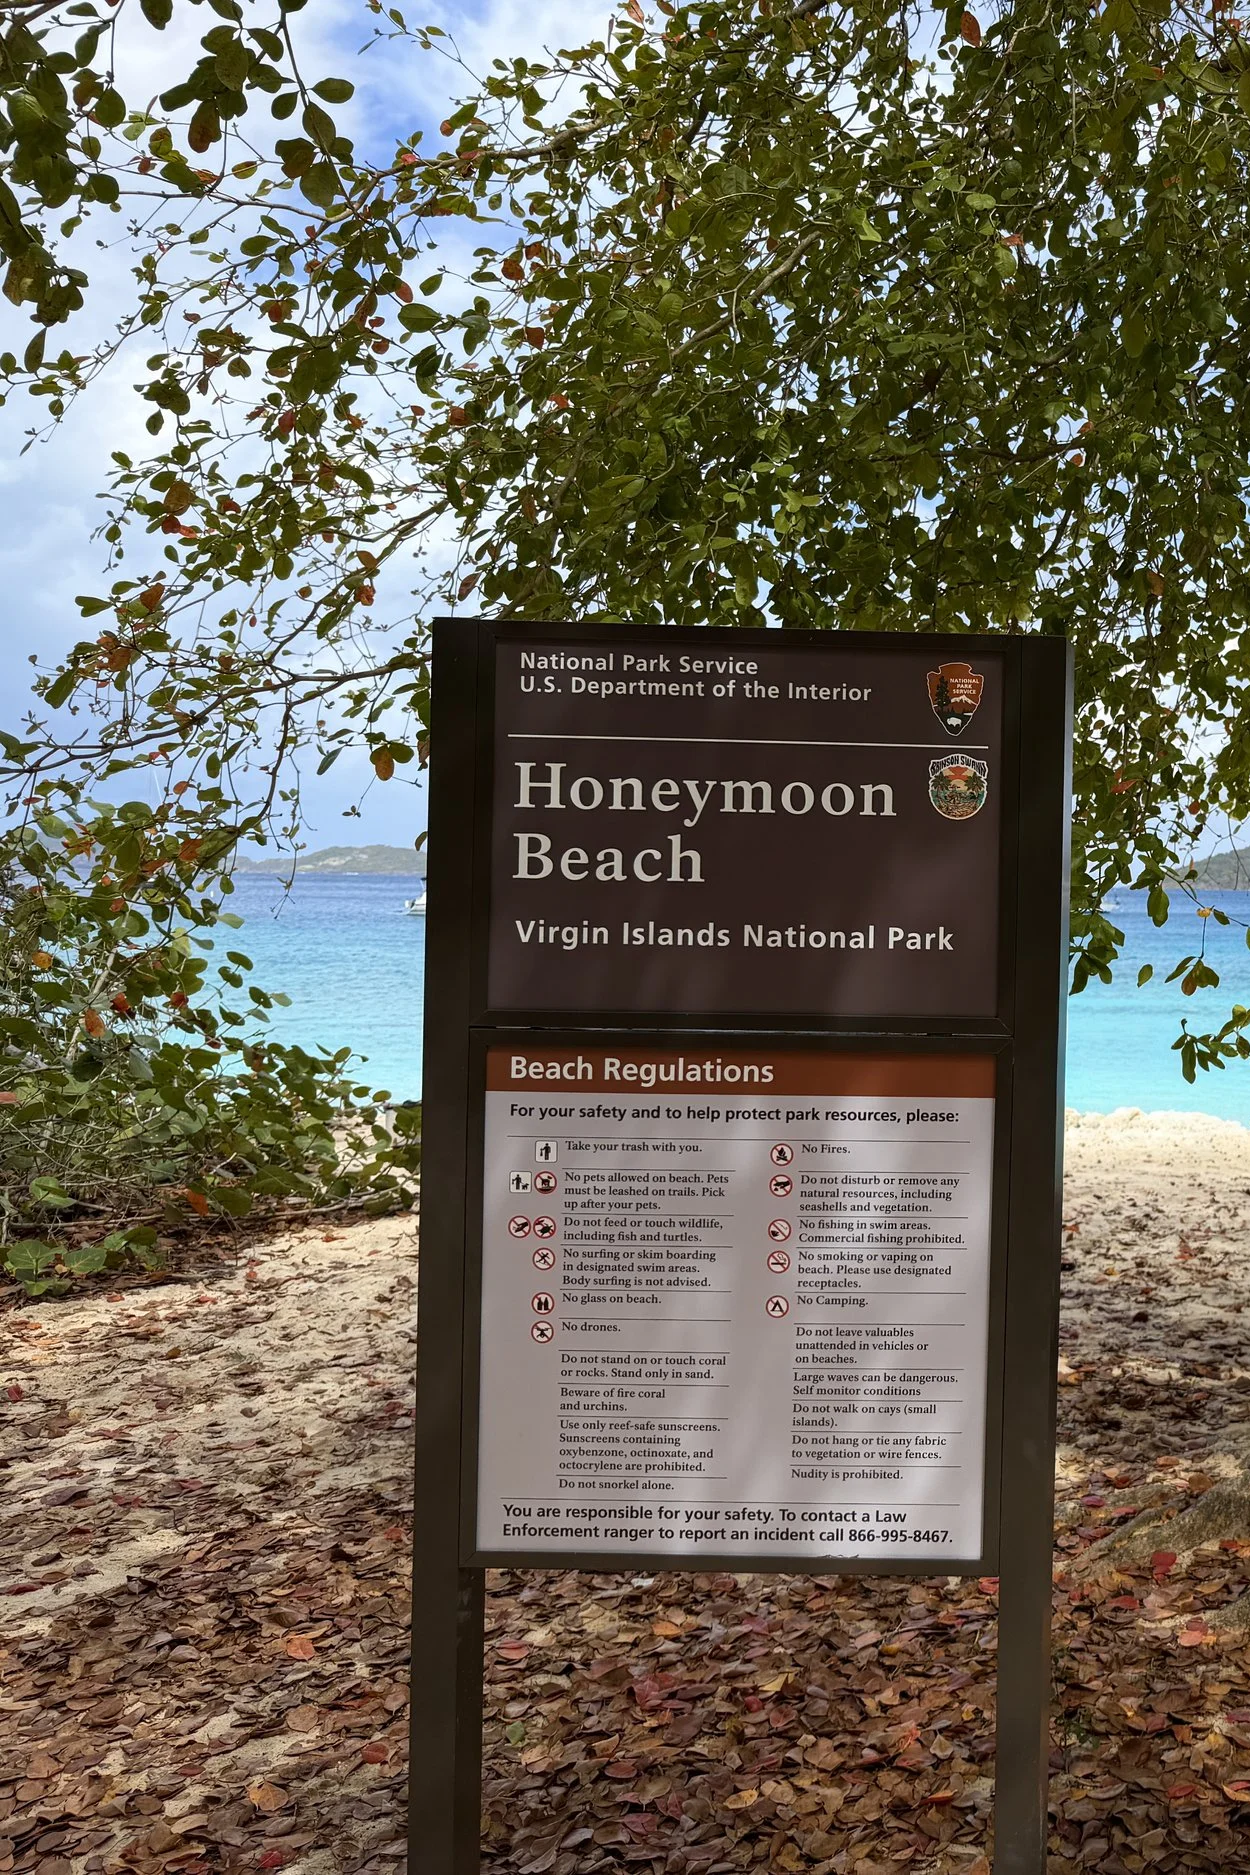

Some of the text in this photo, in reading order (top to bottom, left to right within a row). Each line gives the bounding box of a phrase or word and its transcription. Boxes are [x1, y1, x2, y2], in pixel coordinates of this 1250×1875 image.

[520, 652, 758, 674] National Park Service
[520, 675, 872, 701] U.S. Department of the Interior
[513, 761, 897, 827] Honeymoon
[512, 833, 705, 882] Beach
[514, 919, 954, 950] Virgin Islands National Park
[510, 1055, 774, 1087] Beach Regulations
[510, 1103, 959, 1125] For your safety and to help protect park resources, please:
[564, 1140, 702, 1154] Take your trash with you.
[801, 1143, 851, 1154] No Fires.
[562, 1292, 661, 1305] No glass on beach.
[796, 1295, 868, 1308] No Camping.
[561, 1321, 621, 1332] No drones.
[558, 1478, 674, 1490] Do not snorkel alone.
[791, 1468, 903, 1481] Nudity is prohibited.
[502, 1504, 907, 1524] You are responsible for your safety. To contact a Law
[502, 1523, 953, 1543] Enforcement ranger to report an incident call 866-995-8467.
